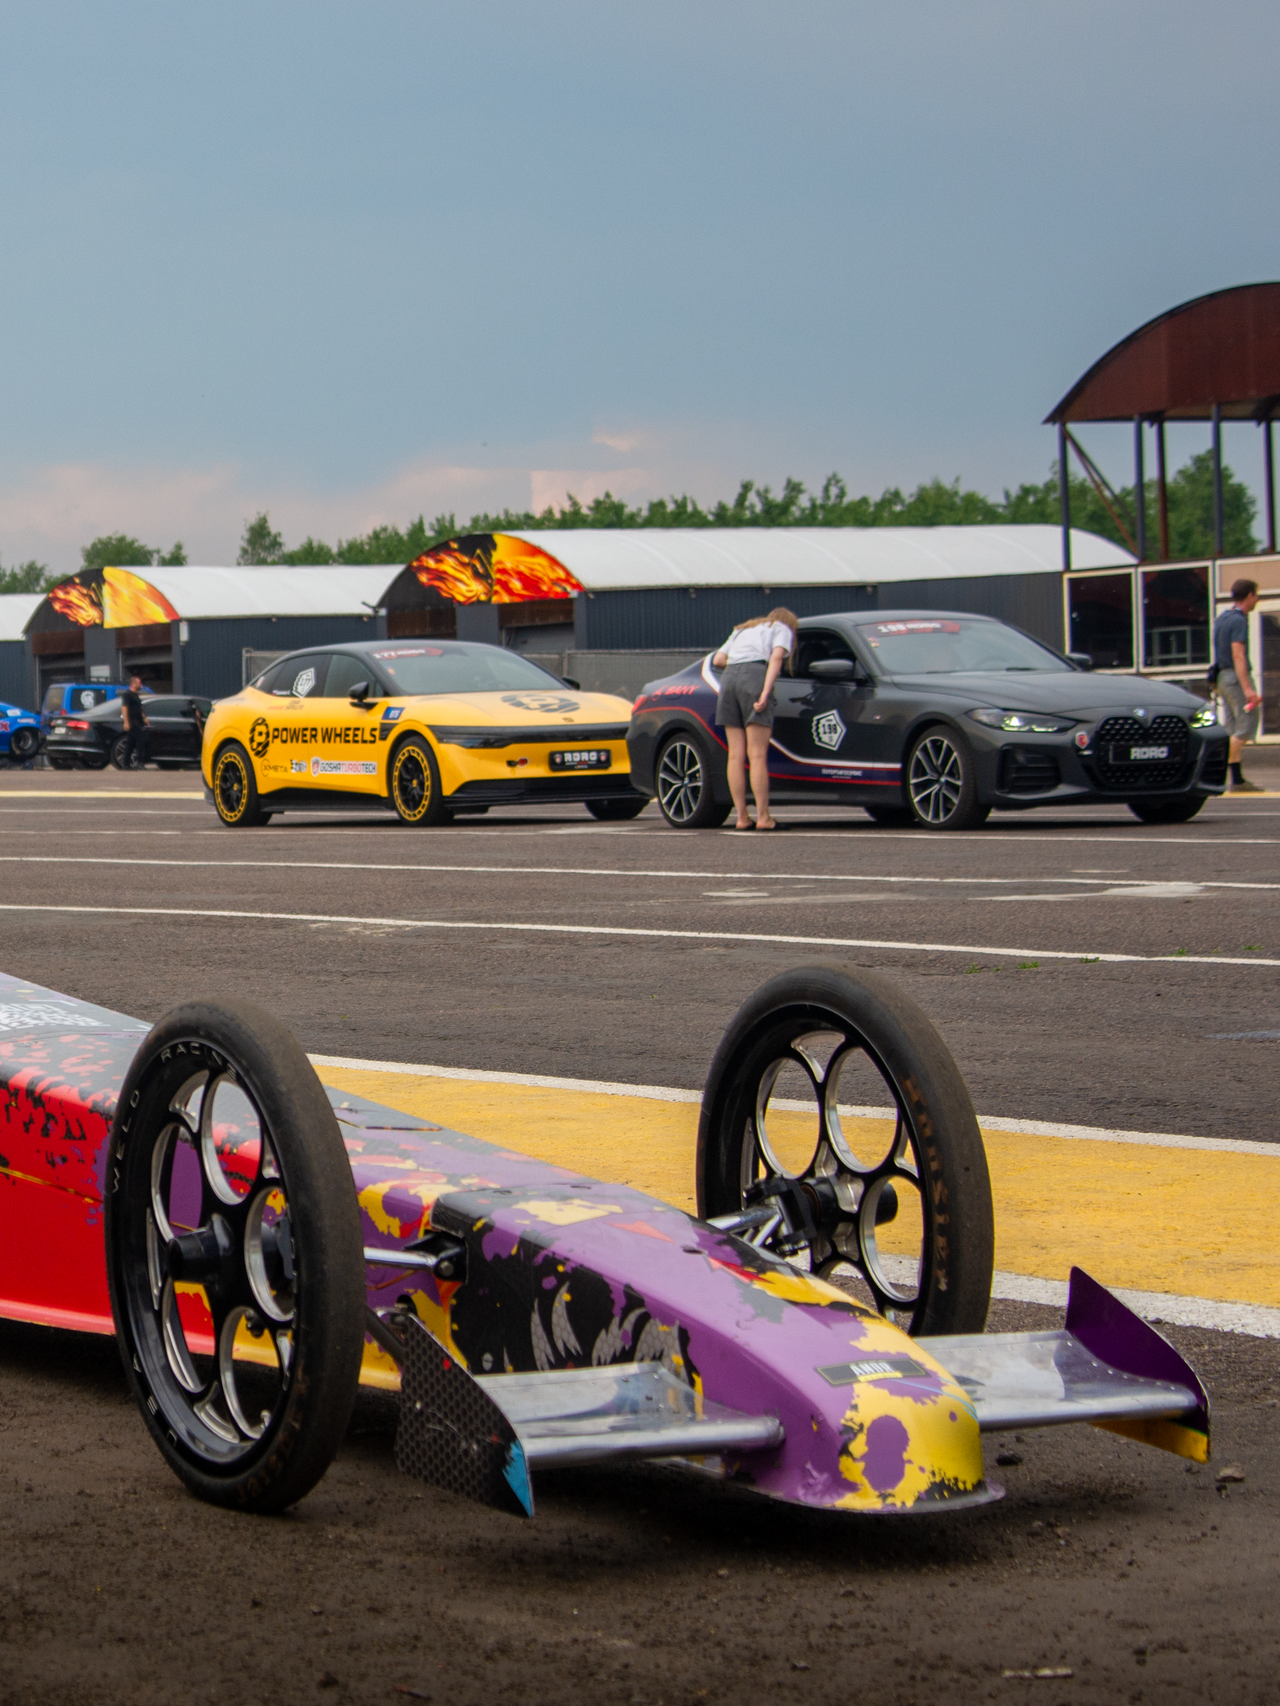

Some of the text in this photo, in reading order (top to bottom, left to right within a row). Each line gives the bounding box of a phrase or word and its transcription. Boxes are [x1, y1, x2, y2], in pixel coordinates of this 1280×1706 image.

[271, 726, 378, 744] POWER WHEELS
[112, 1089, 140, 1194] WELD
